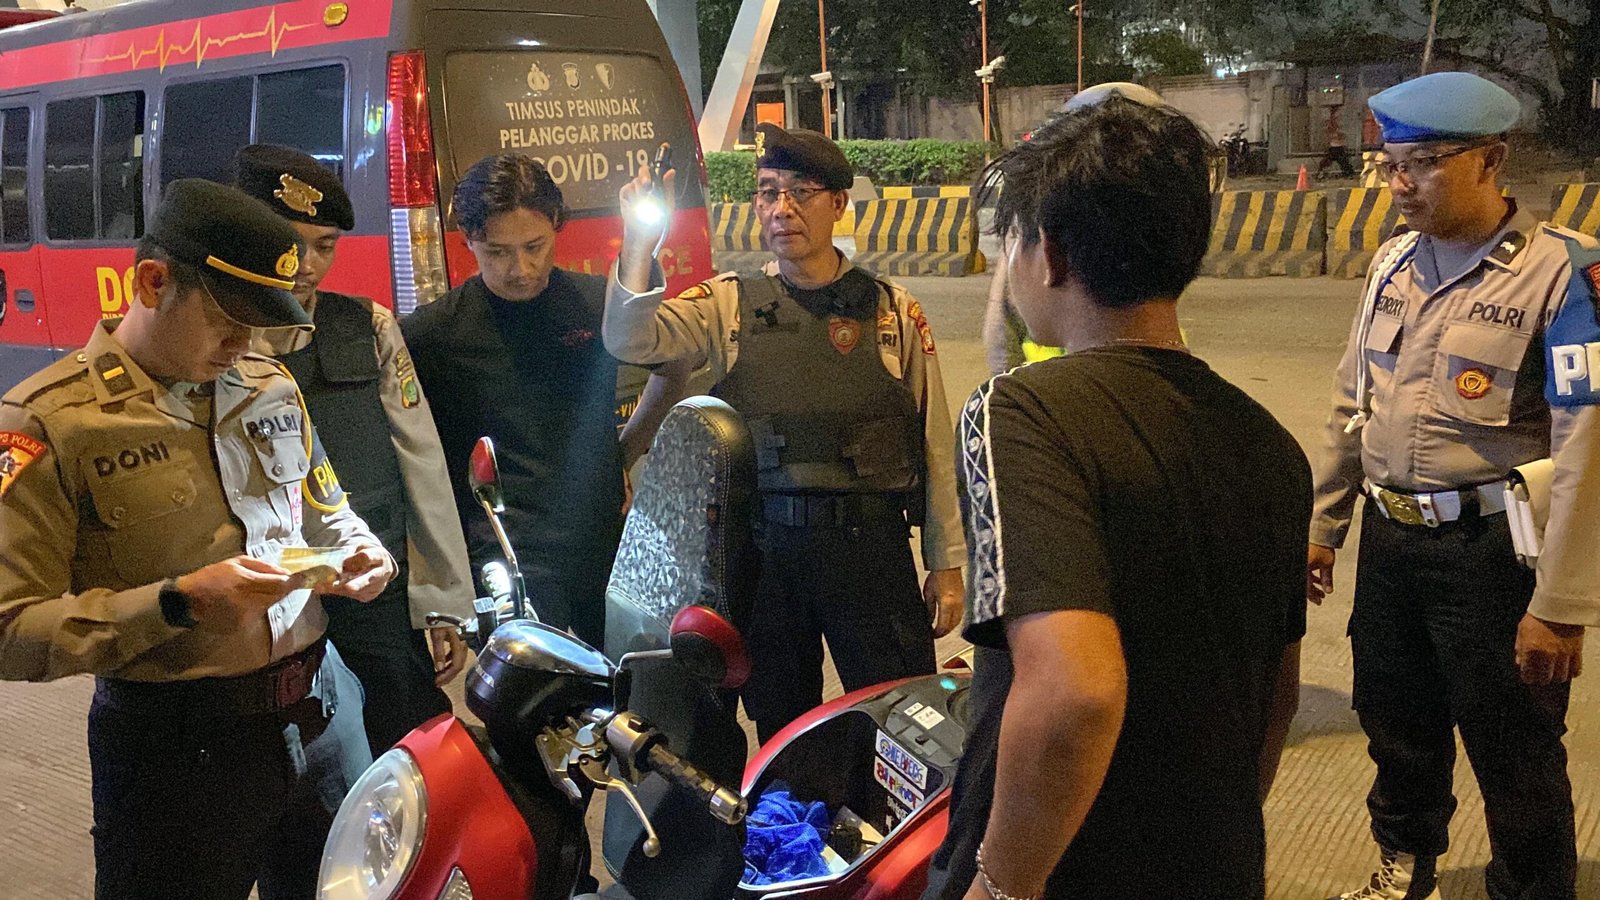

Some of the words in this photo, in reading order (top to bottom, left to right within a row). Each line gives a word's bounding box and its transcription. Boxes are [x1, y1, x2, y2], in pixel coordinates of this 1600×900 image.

[505, 100, 564, 121] TIMSUS
[567, 98, 640, 118] PENINDAK
[500, 125, 600, 149] PELANGGAR
[603, 121, 655, 142] PROKES
[1468, 301, 1526, 328] POLRI
[246, 414, 299, 438] POLRI
[11, 434, 43, 455] POLRI
[94, 440, 170, 477] DONI
